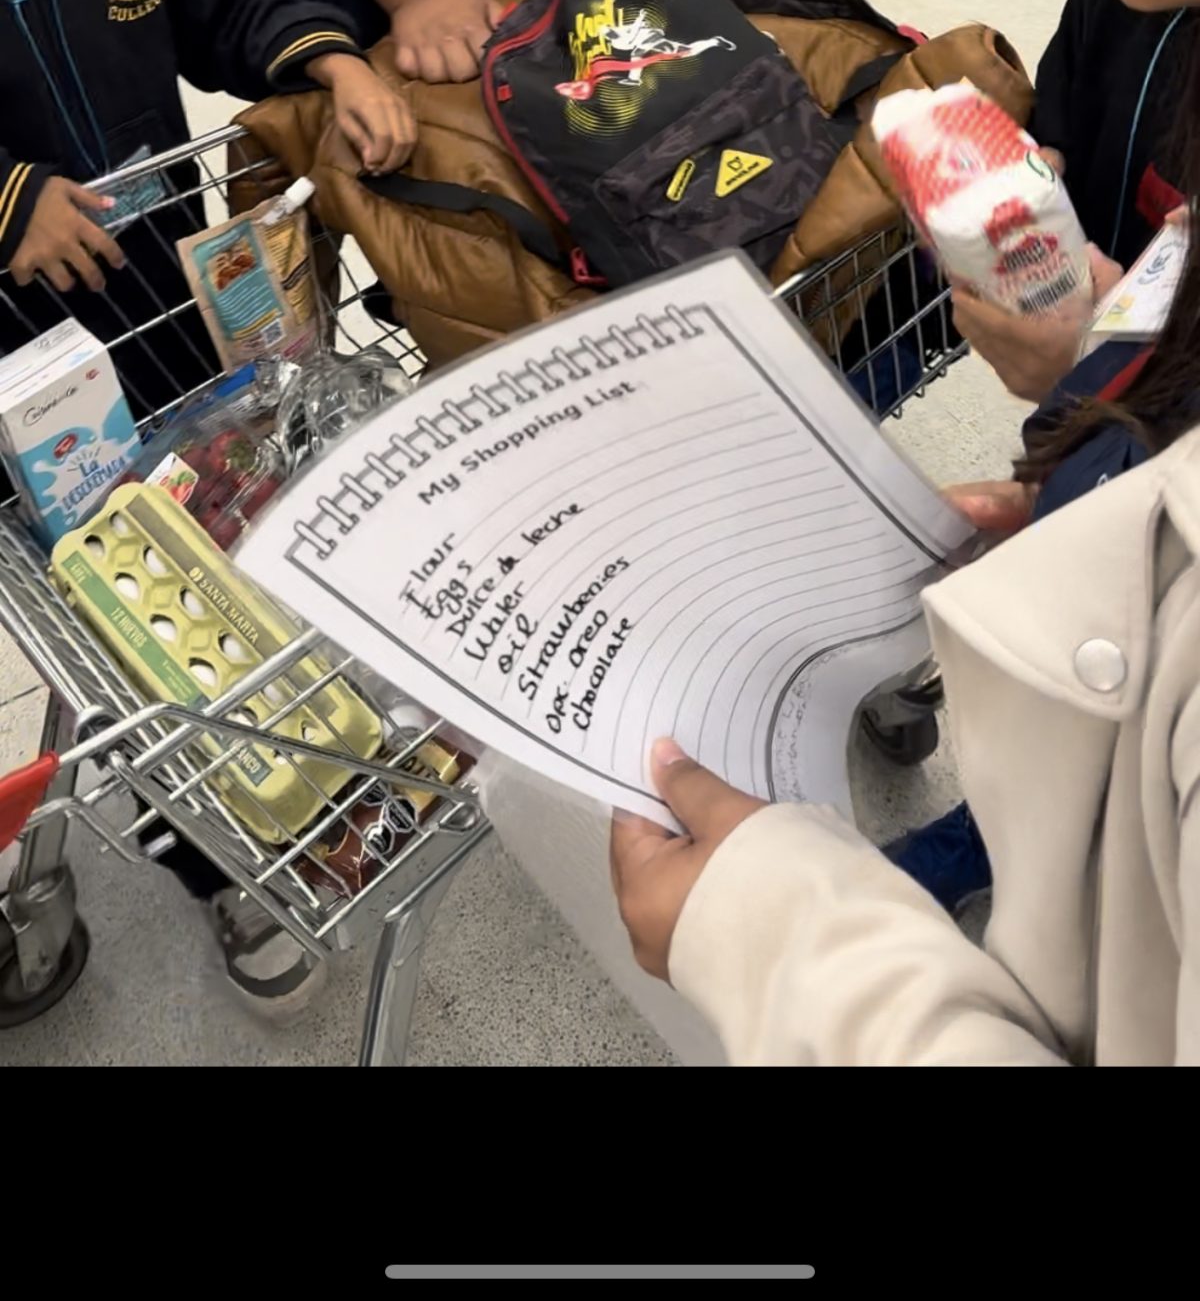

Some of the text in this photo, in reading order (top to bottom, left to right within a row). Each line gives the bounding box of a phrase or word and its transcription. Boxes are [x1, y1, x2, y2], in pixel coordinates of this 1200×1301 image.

[418, 380, 636, 505] My Shopping List
[399, 533, 456, 610] Flour
[420, 559, 474, 620] Eggs
[446, 577, 496, 638] Dulce
[520, 502, 584, 547] leche
[463, 581, 524, 661] Water
